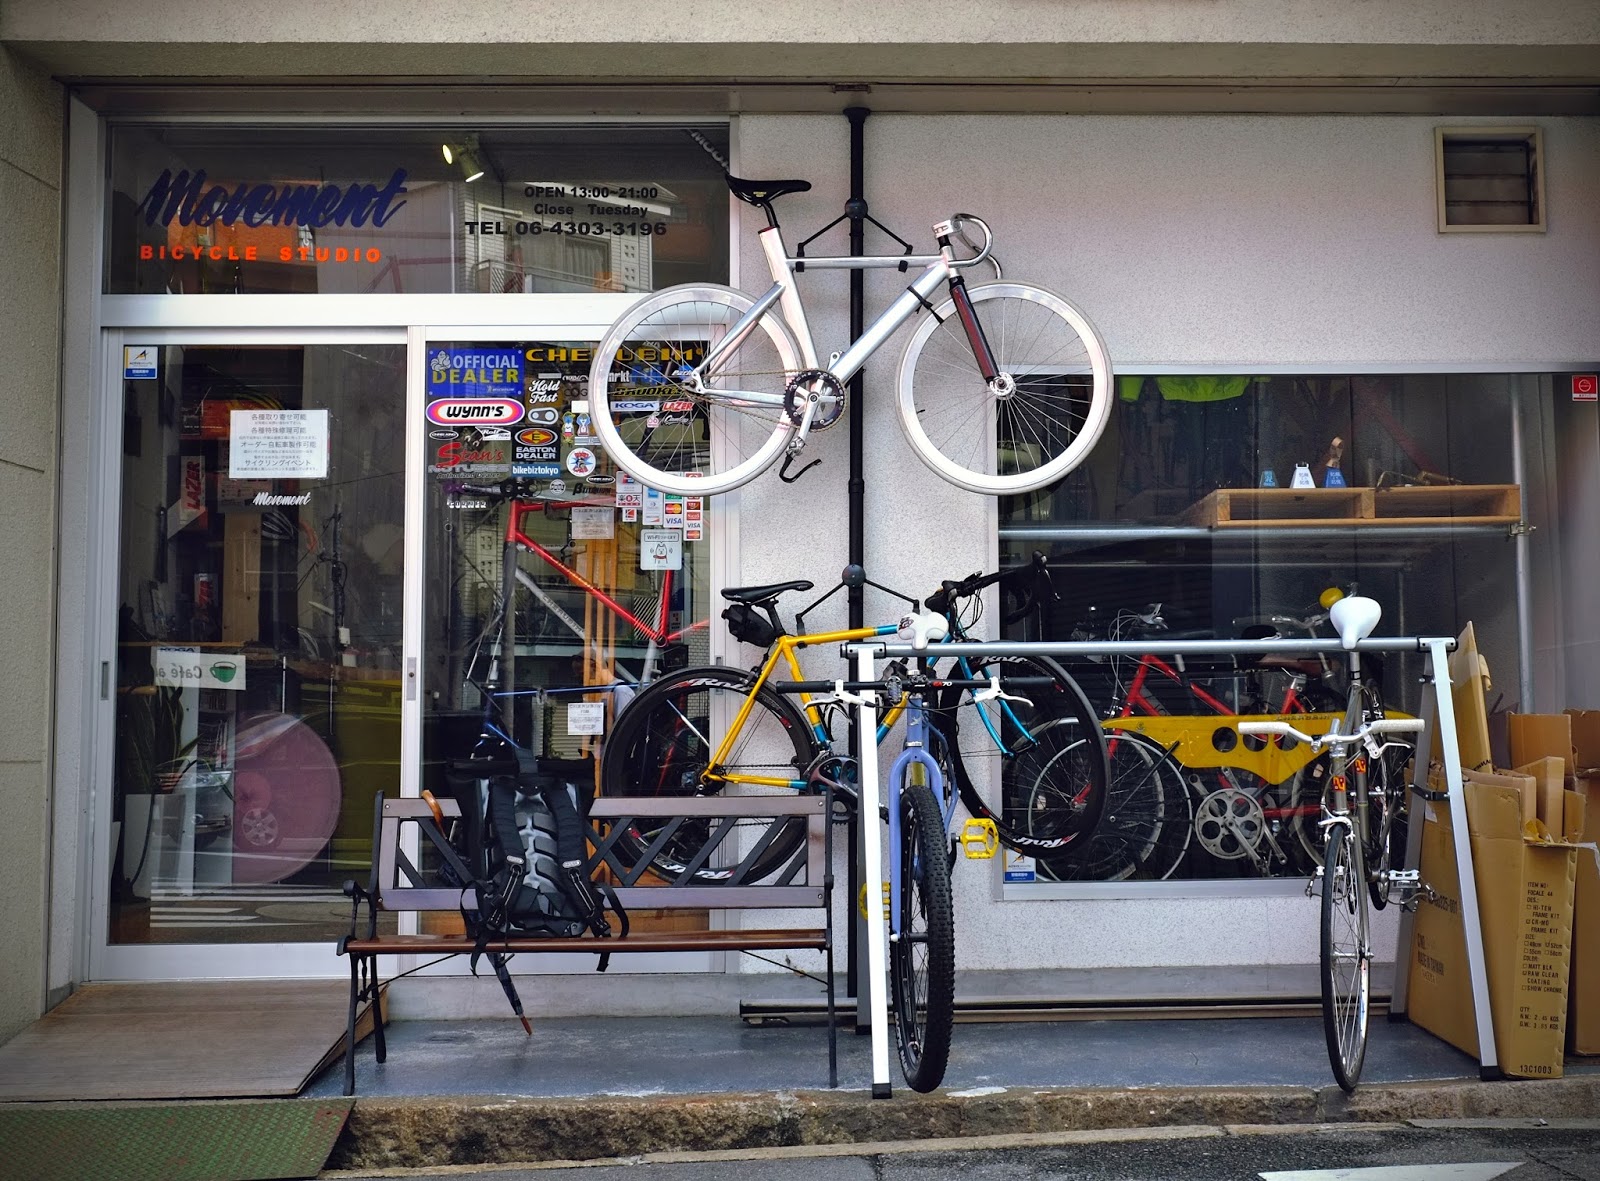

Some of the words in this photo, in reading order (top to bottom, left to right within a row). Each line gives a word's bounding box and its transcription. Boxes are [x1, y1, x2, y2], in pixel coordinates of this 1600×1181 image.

[135, 167, 408, 228] Movement
[524, 187, 565, 198] OPEN
[534, 204, 574, 215] Close
[588, 204, 648, 217] Tuesday
[465, 222, 507, 235] TEL
[515, 221, 667, 236] 06-4303-3196
[140, 245, 257, 261] BICYCLE
[279, 246, 382, 263] STUDIO
[525, 348, 693, 361] CHEUBIM
[453, 355, 519, 368] OFFICIAL
[432, 369, 519, 383] DEALER
[529, 380, 560, 392] Hold
[529, 391, 558, 404] Fast
[446, 405, 505, 418] wynn's
[663, 400, 694, 411] LAZER
[435, 442, 504, 468] Stan's
[512, 465, 559, 475] bikebiztokyo
[252, 491, 312, 506] Movement
[1519, 1064, 1552, 1075] 13C1003
